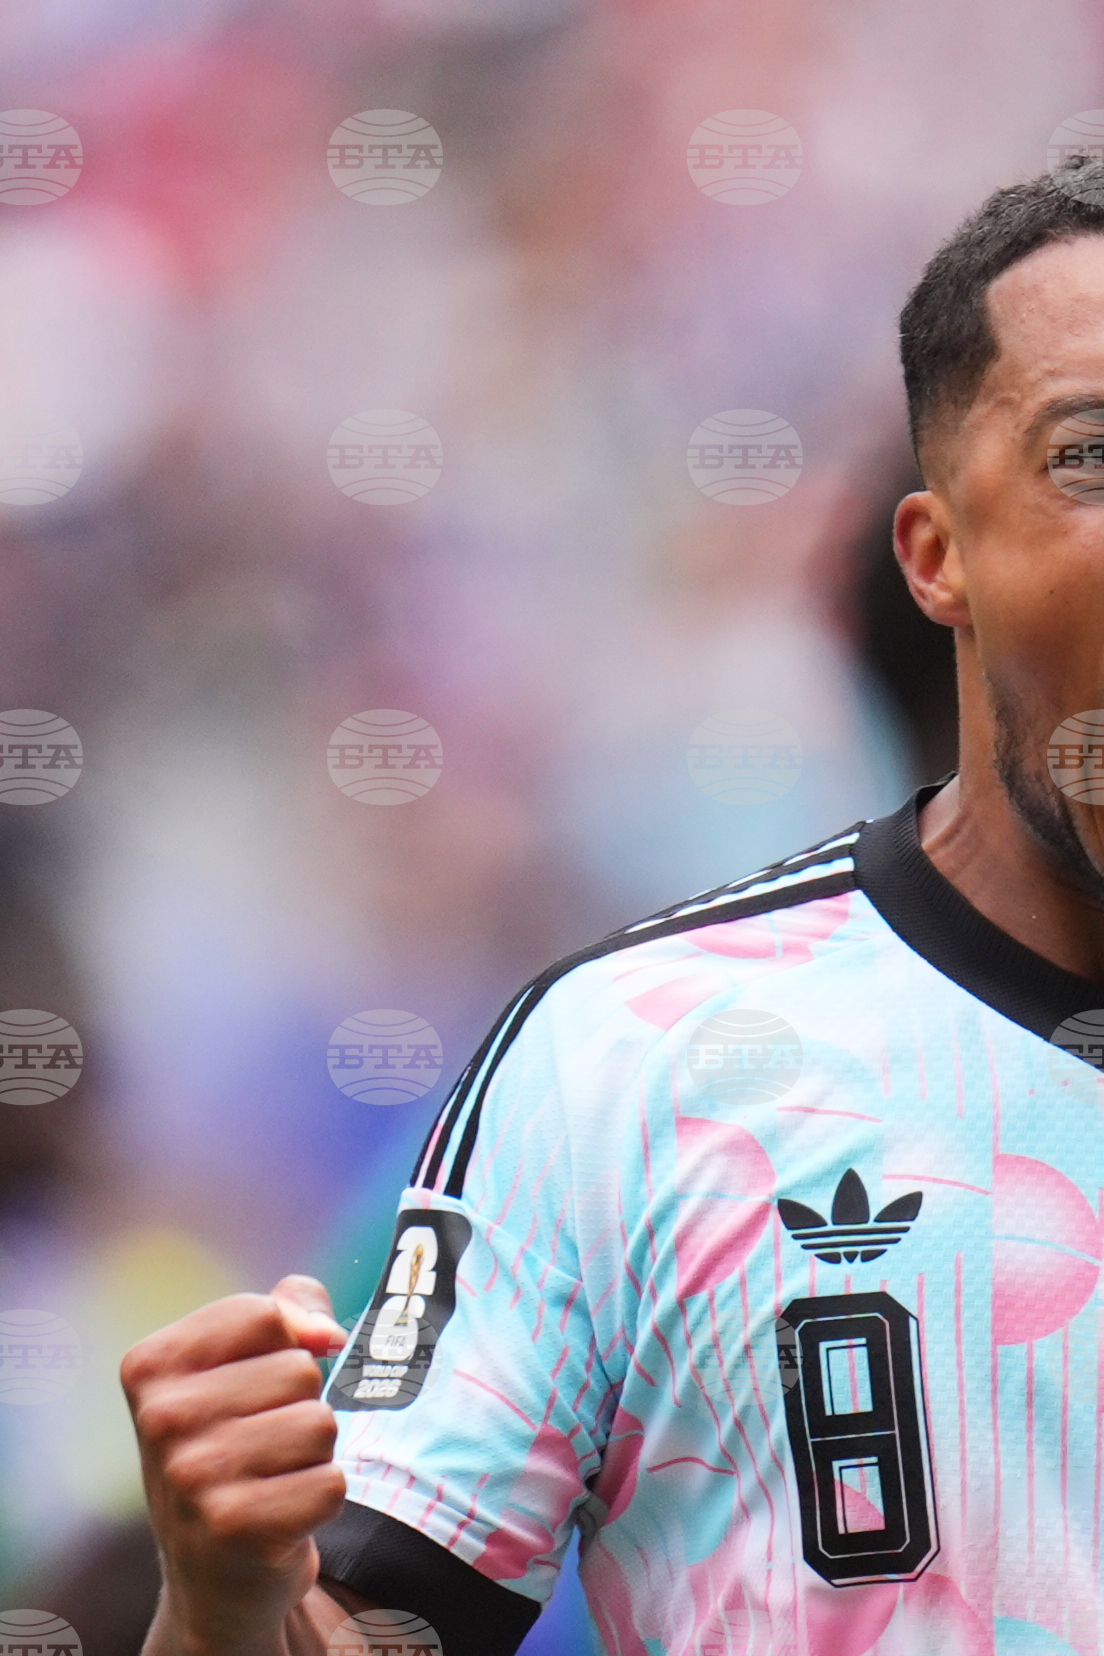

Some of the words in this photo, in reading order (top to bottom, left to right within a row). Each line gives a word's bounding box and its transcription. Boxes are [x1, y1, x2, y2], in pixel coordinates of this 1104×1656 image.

[384, 1335, 406, 1347] FIFA
[362, 1364, 391, 1378] WORLD
[388, 1364, 409, 1378] CUP
[353, 1379, 402, 1398] 2026
[775, 1291, 940, 1588] 8
